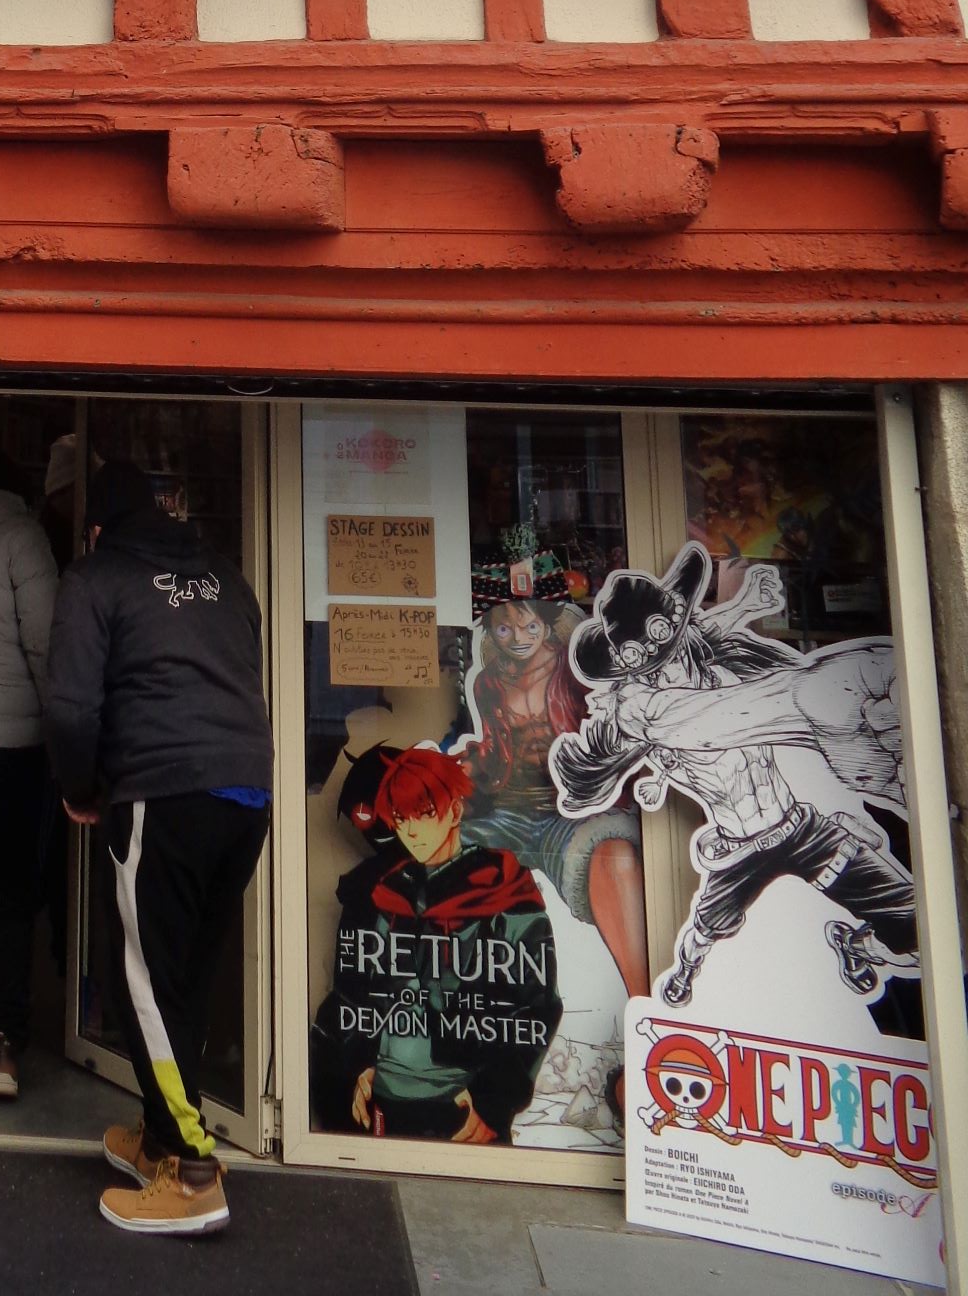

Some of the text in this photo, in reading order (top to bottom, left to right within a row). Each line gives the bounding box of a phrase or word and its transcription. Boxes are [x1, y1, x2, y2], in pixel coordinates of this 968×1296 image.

[330, 519, 375, 536] STAGE
[351, 571, 377, 584] 65€
[399, 608, 436, 624] K-POP
[334, 627, 354, 641] 16
[340, 929, 547, 987] THE RETURN
[400, 988, 485, 1010] OF THE
[339, 1006, 547, 1046] DEMON MASTER
[799, 1056, 937, 1162] PIEC
[667, 1148, 699, 1164] BOICHI
[680, 1163, 695, 1175] RYO
[697, 1167, 736, 1182] ISHIYAMA
[693, 1177, 727, 1192] EIICHIRO
[728, 1184, 746, 1196] ODA
[831, 1182, 897, 1205] episode
